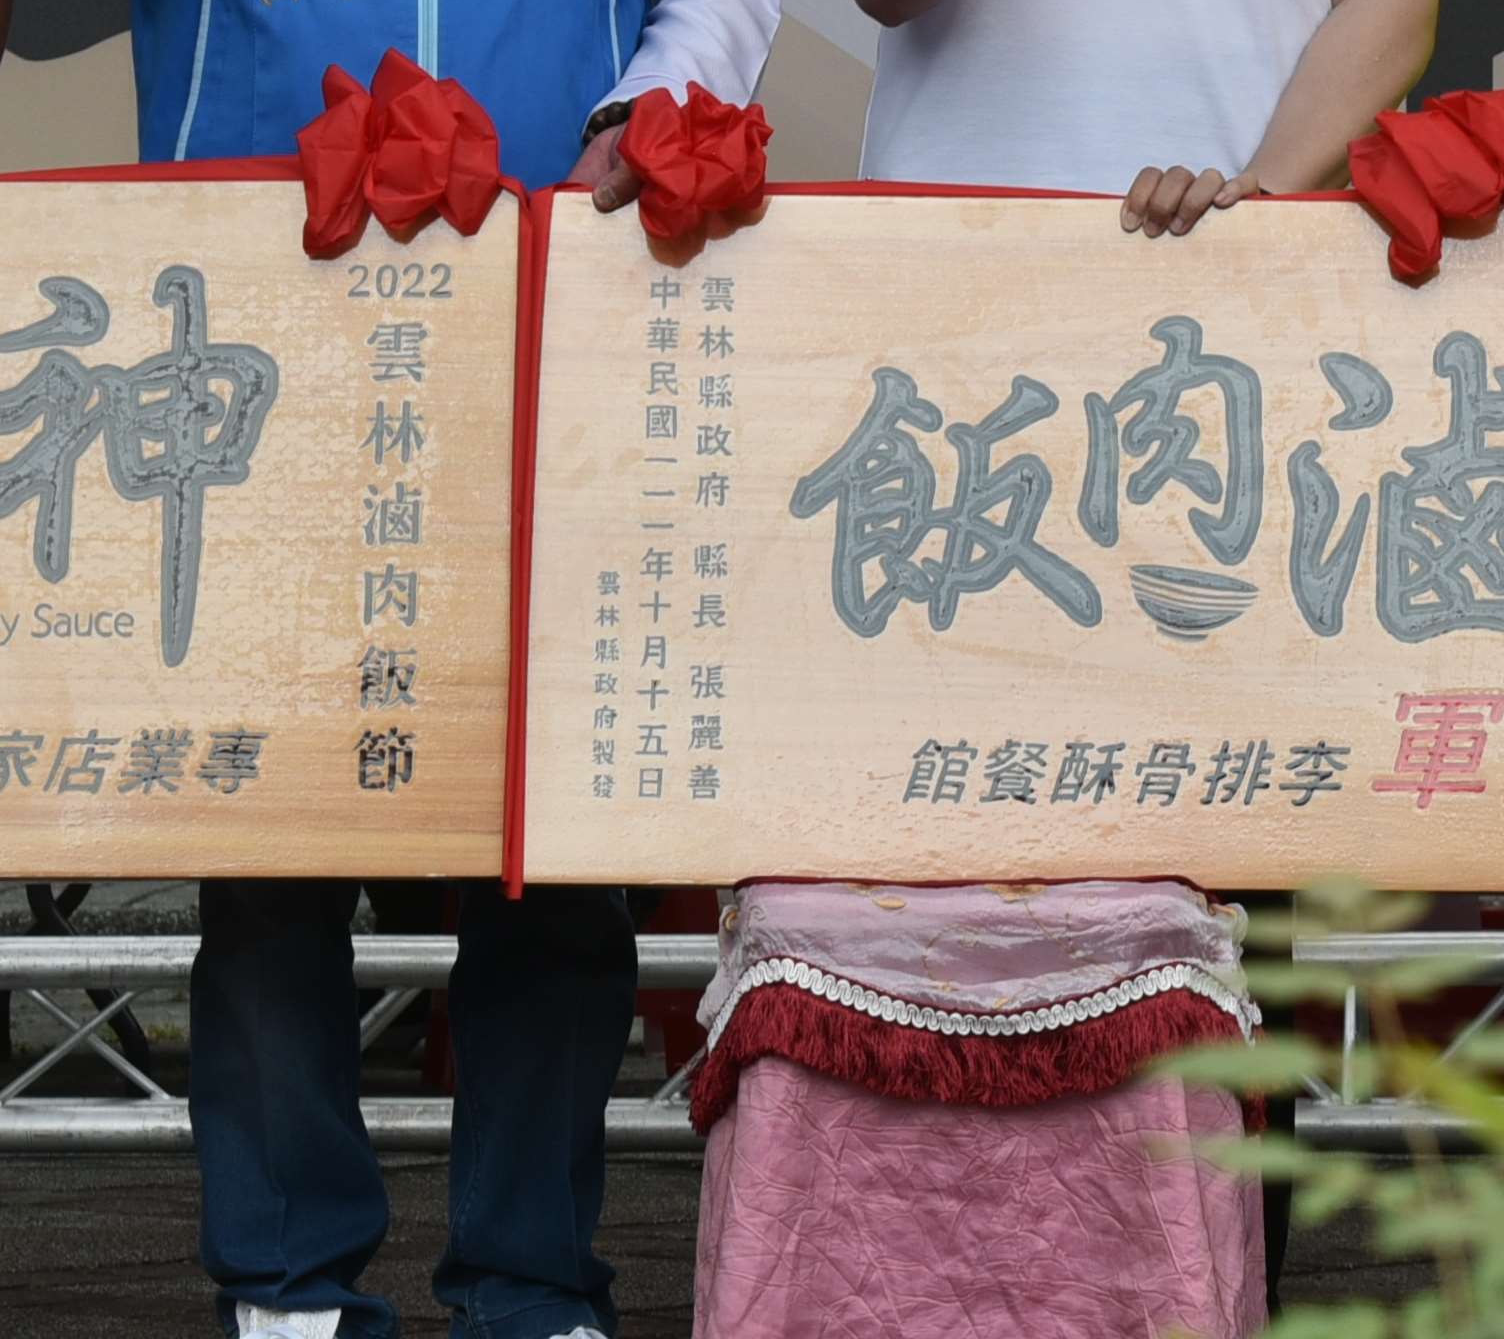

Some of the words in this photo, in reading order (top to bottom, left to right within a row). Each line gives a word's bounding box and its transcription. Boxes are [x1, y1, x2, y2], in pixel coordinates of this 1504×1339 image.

[346, 261, 454, 301] 2022
[694, 274, 736, 509] 雲林縣政府
[31, 604, 135, 639] Sauce
[352, 321, 431, 793] 雲林滷肉飯節
[636, 274, 683, 801] 中華民國一一一年十月十五日
[691, 543, 730, 632] 縣長
[591, 569, 622, 801] 雲林縣政府製發
[686, 664, 727, 802] 張麗善
